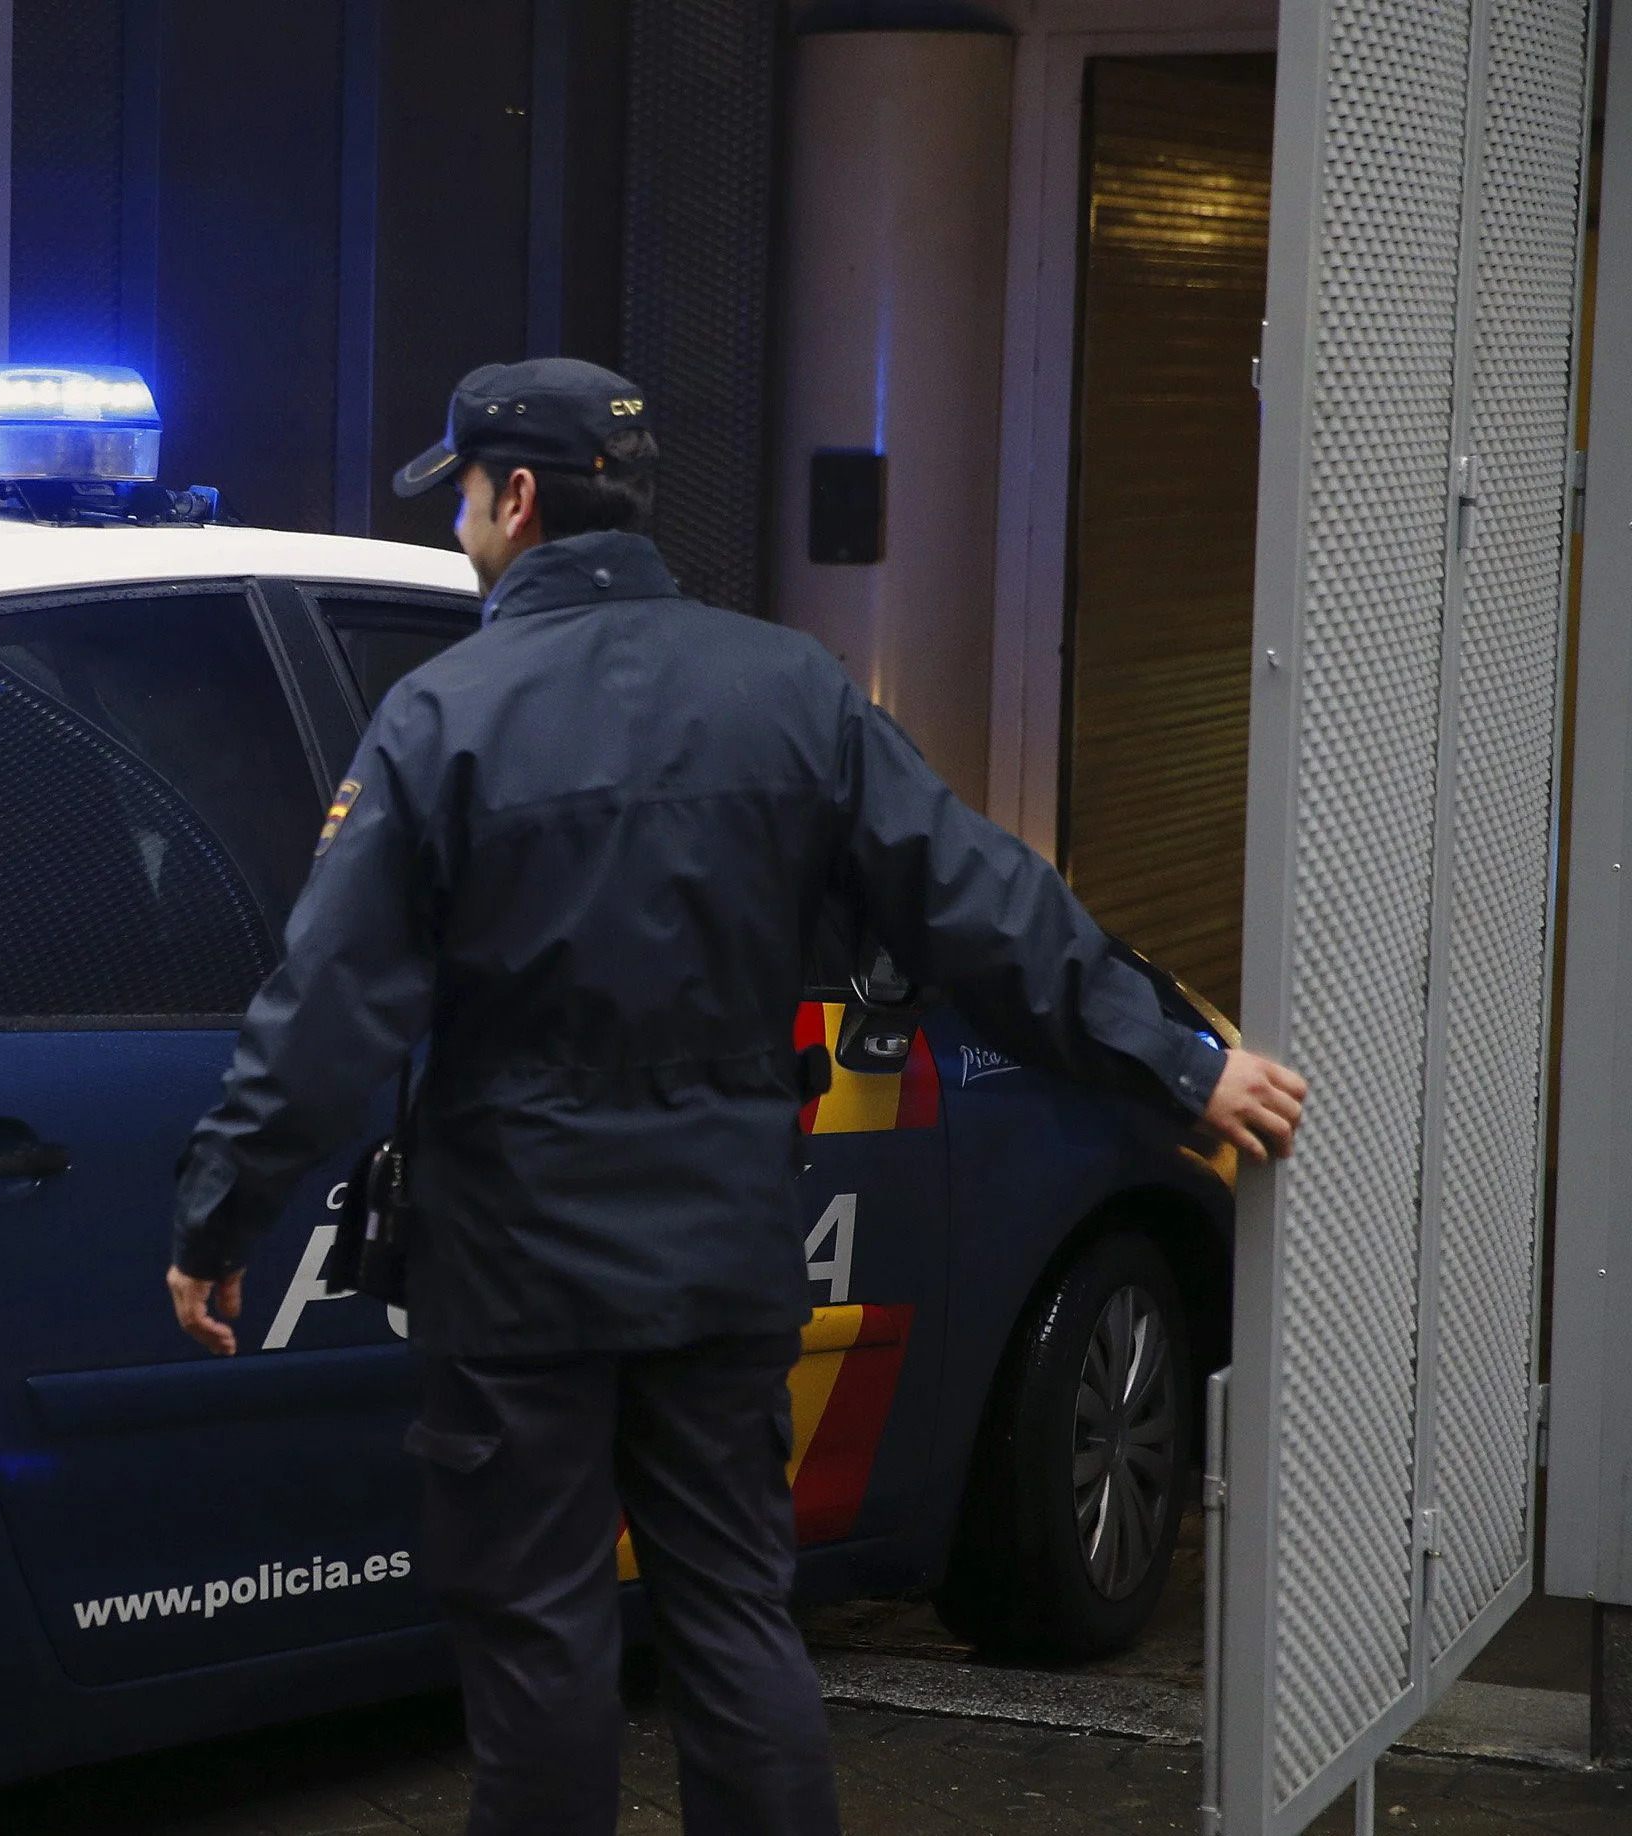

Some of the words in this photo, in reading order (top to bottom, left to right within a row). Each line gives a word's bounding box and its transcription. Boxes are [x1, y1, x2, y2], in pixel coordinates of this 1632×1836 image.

[610, 400, 644, 416] CNP
[958, 1044, 1012, 1087] Pica
[73, 1549, 411, 1630] www.policia.es
